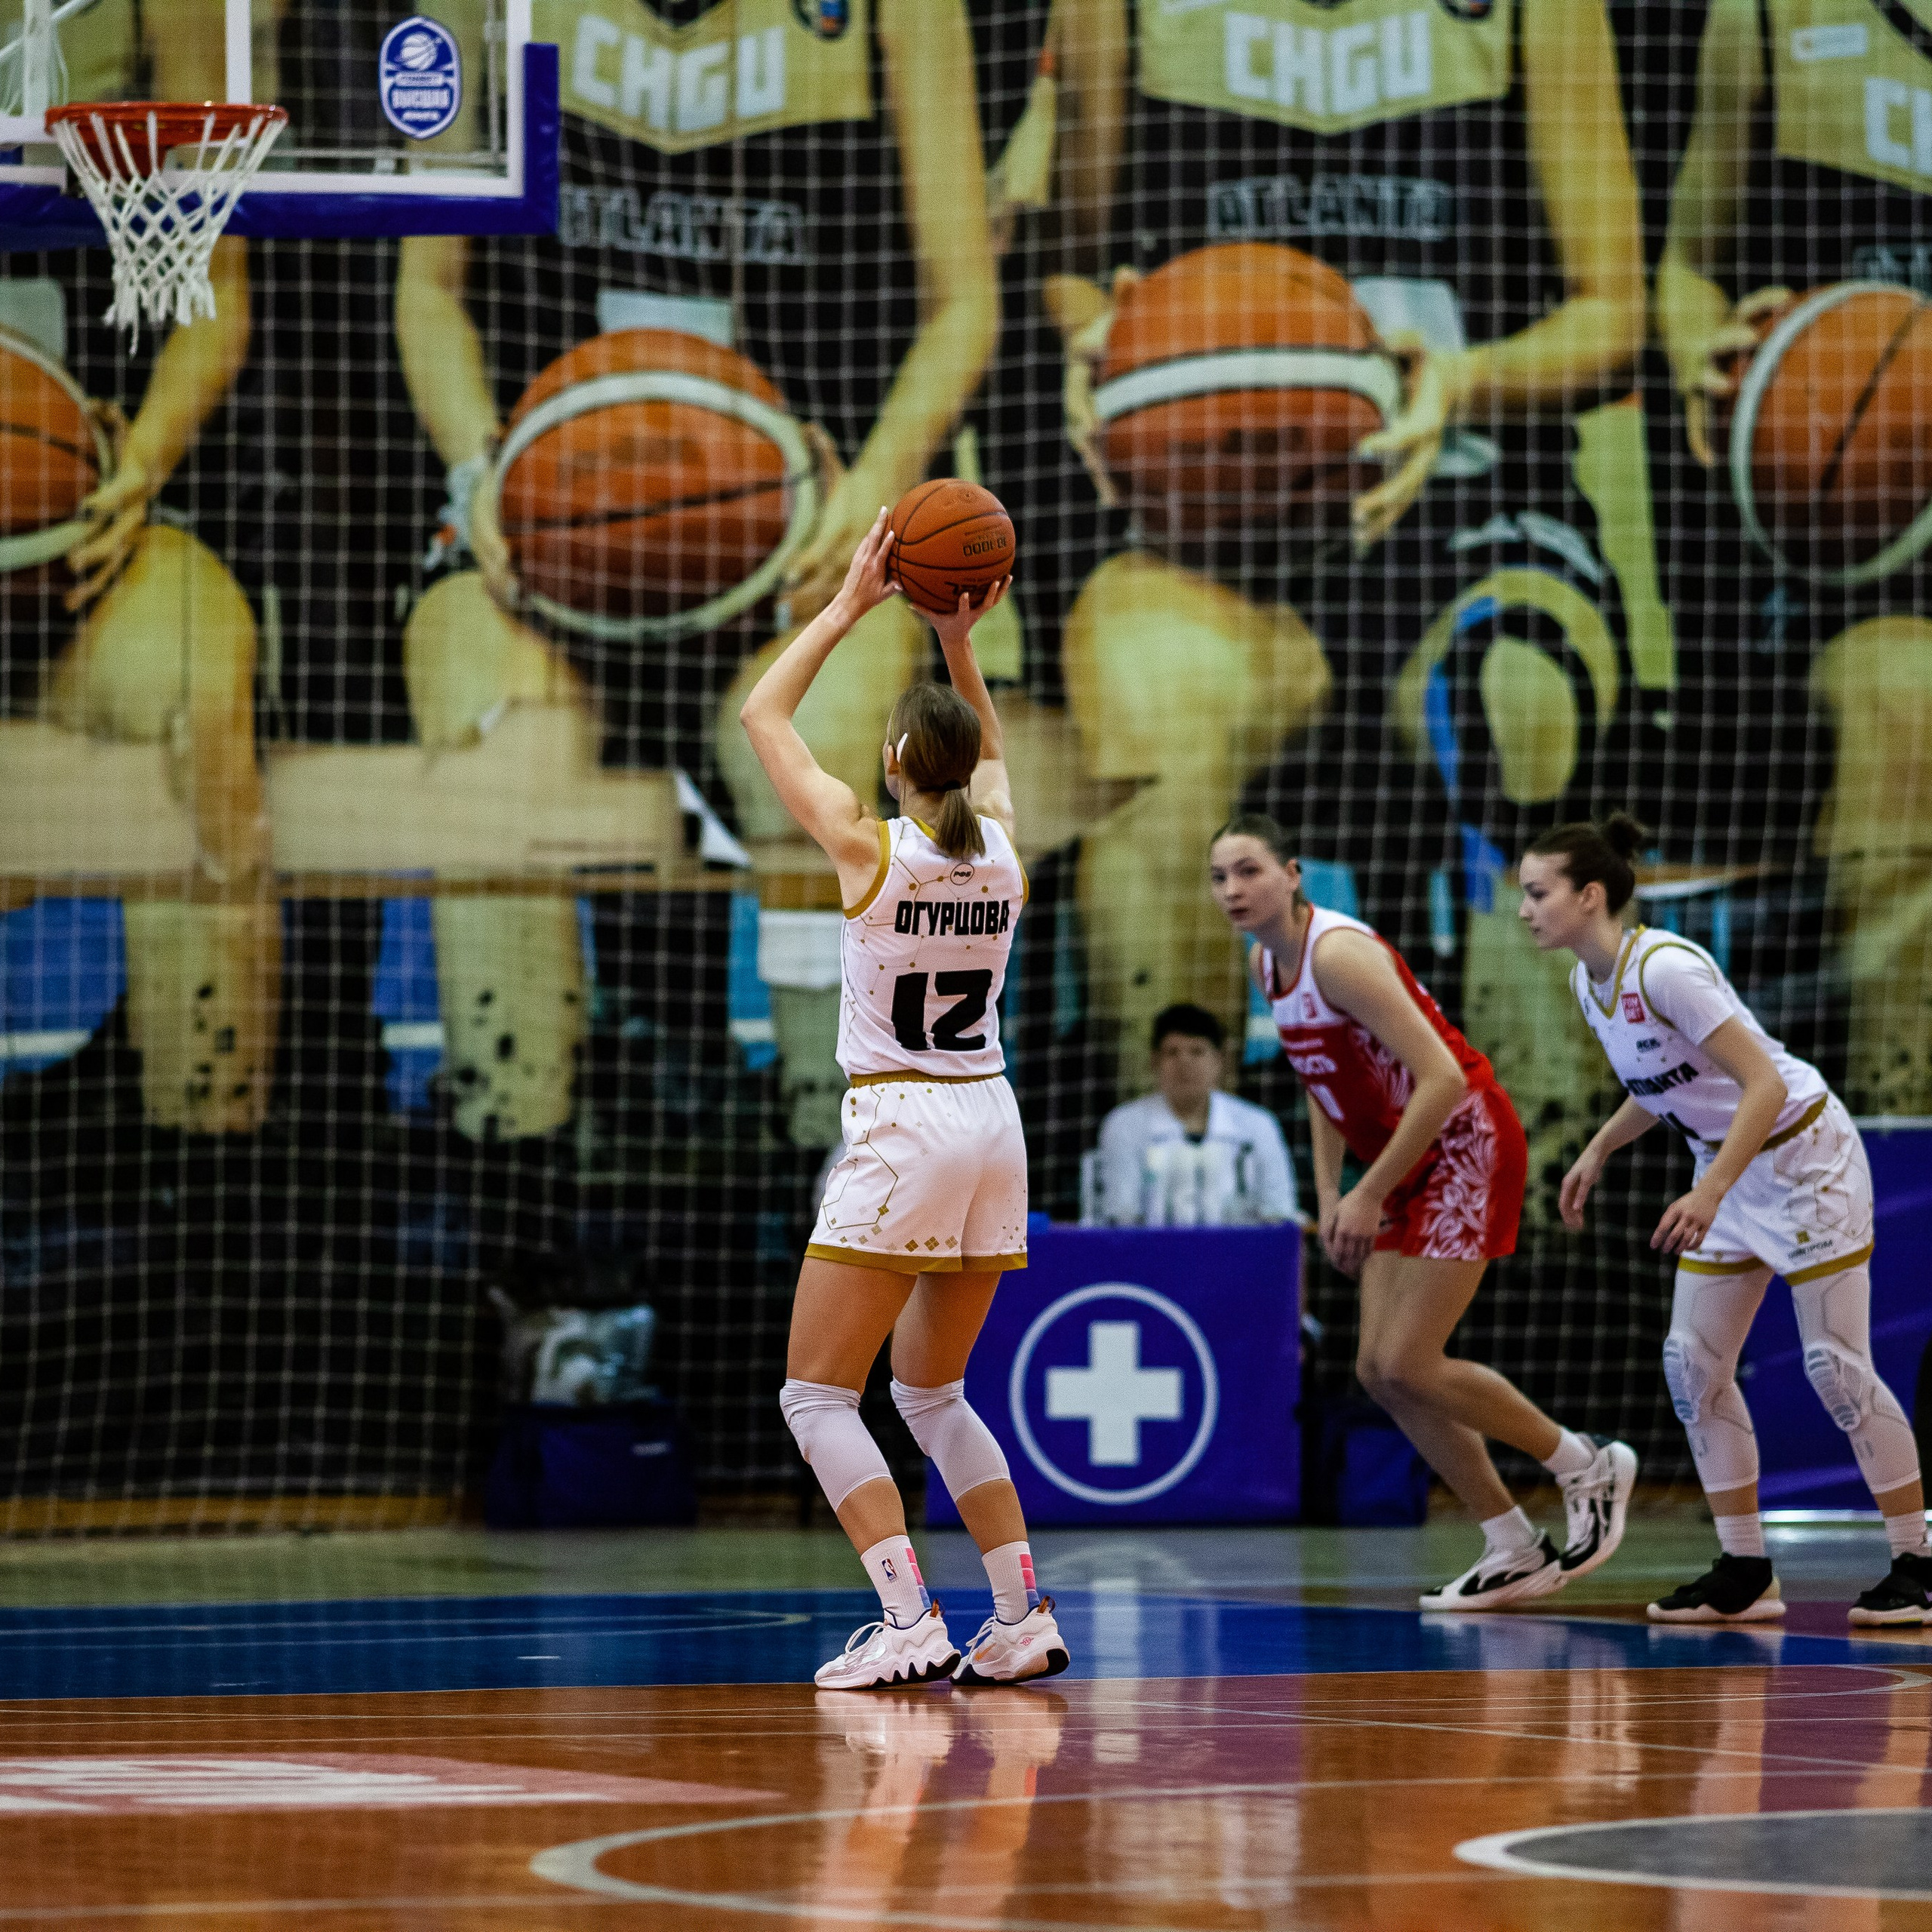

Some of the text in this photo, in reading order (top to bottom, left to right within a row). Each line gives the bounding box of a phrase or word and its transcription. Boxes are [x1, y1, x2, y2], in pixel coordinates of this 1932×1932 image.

[571, 14, 786, 132] CHGU
[1224, 11, 1432, 116] CHGU
[894, 899, 1010, 937] ОГУРЦОВА
[891, 968, 994, 1051] 12
